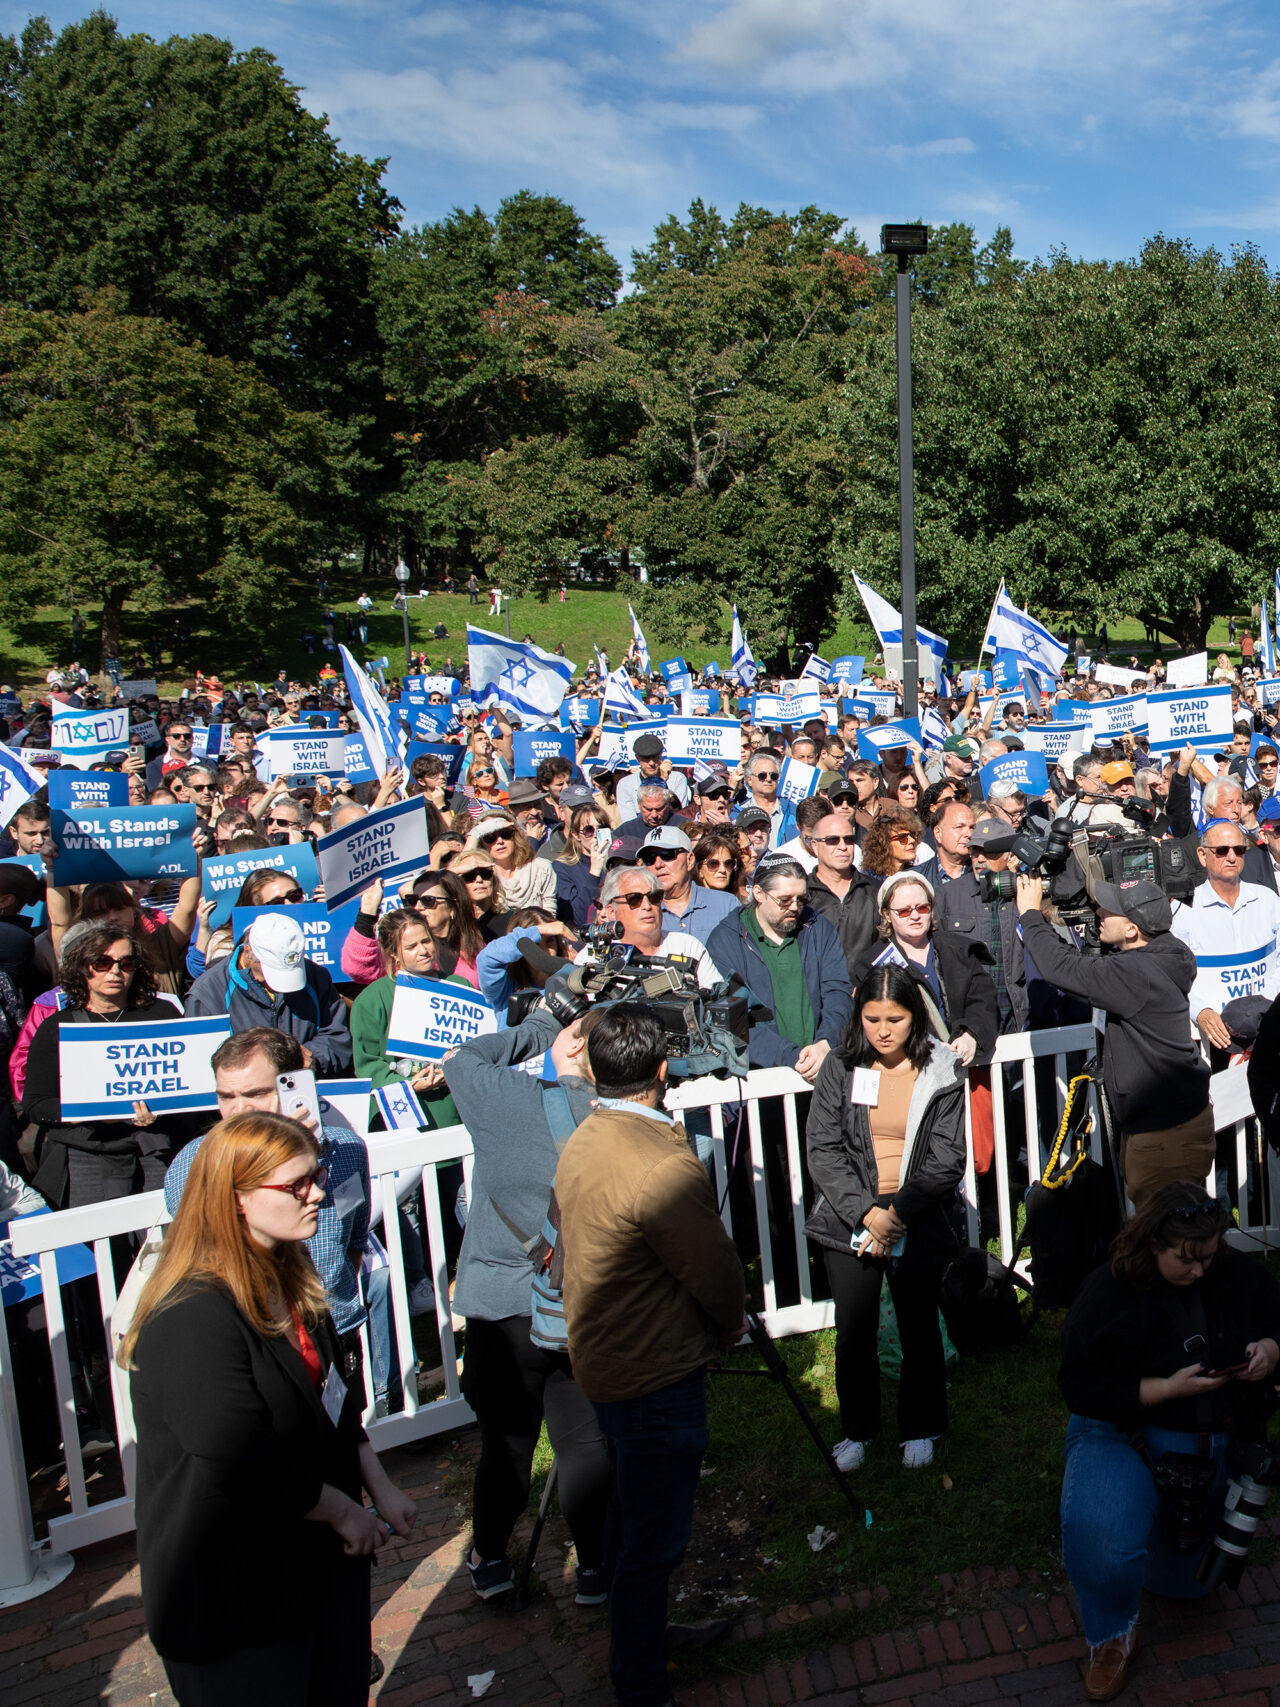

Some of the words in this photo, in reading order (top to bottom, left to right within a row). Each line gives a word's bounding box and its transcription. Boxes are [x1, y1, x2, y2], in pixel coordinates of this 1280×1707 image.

[1106, 704, 1135, 716] STAND
[1169, 700, 1209, 713] STAND
[1108, 719, 1137, 730] ISRAEL
[1110, 712, 1133, 724] WITH
[1174, 712, 1206, 724] WITH
[687, 728, 723, 737] STAND
[1170, 723, 1212, 737] ISRAEL
[292, 741, 328, 750] STAND
[531, 741, 562, 749] STAND
[691, 737, 719, 746] WITH
[297, 752, 326, 760] WITH
[686, 747, 723, 757] ISRAEL
[292, 761, 330, 770] ISRAEL
[993, 760, 1028, 774] STAND
[997, 768, 1026, 779] WITH
[71, 782, 110, 790] STAND
[75, 791, 108, 800] WITH
[62, 821, 105, 835] ADL
[109, 818, 179, 833] Stands
[62, 836, 111, 849] With
[116, 833, 171, 848] Israel
[346, 822, 396, 853] STAND
[352, 837, 392, 864] WITH
[207, 863, 235, 878] We
[238, 854, 284, 873] Stand
[349, 850, 400, 882] ISRAEL
[1221, 963, 1267, 983] STAND
[428, 996, 485, 1021] STAND
[434, 1012, 480, 1035] WITH
[105, 1041, 186, 1060] STAND
[113, 1059, 180, 1078] WITH
[105, 1076, 190, 1098] ISRAEL
